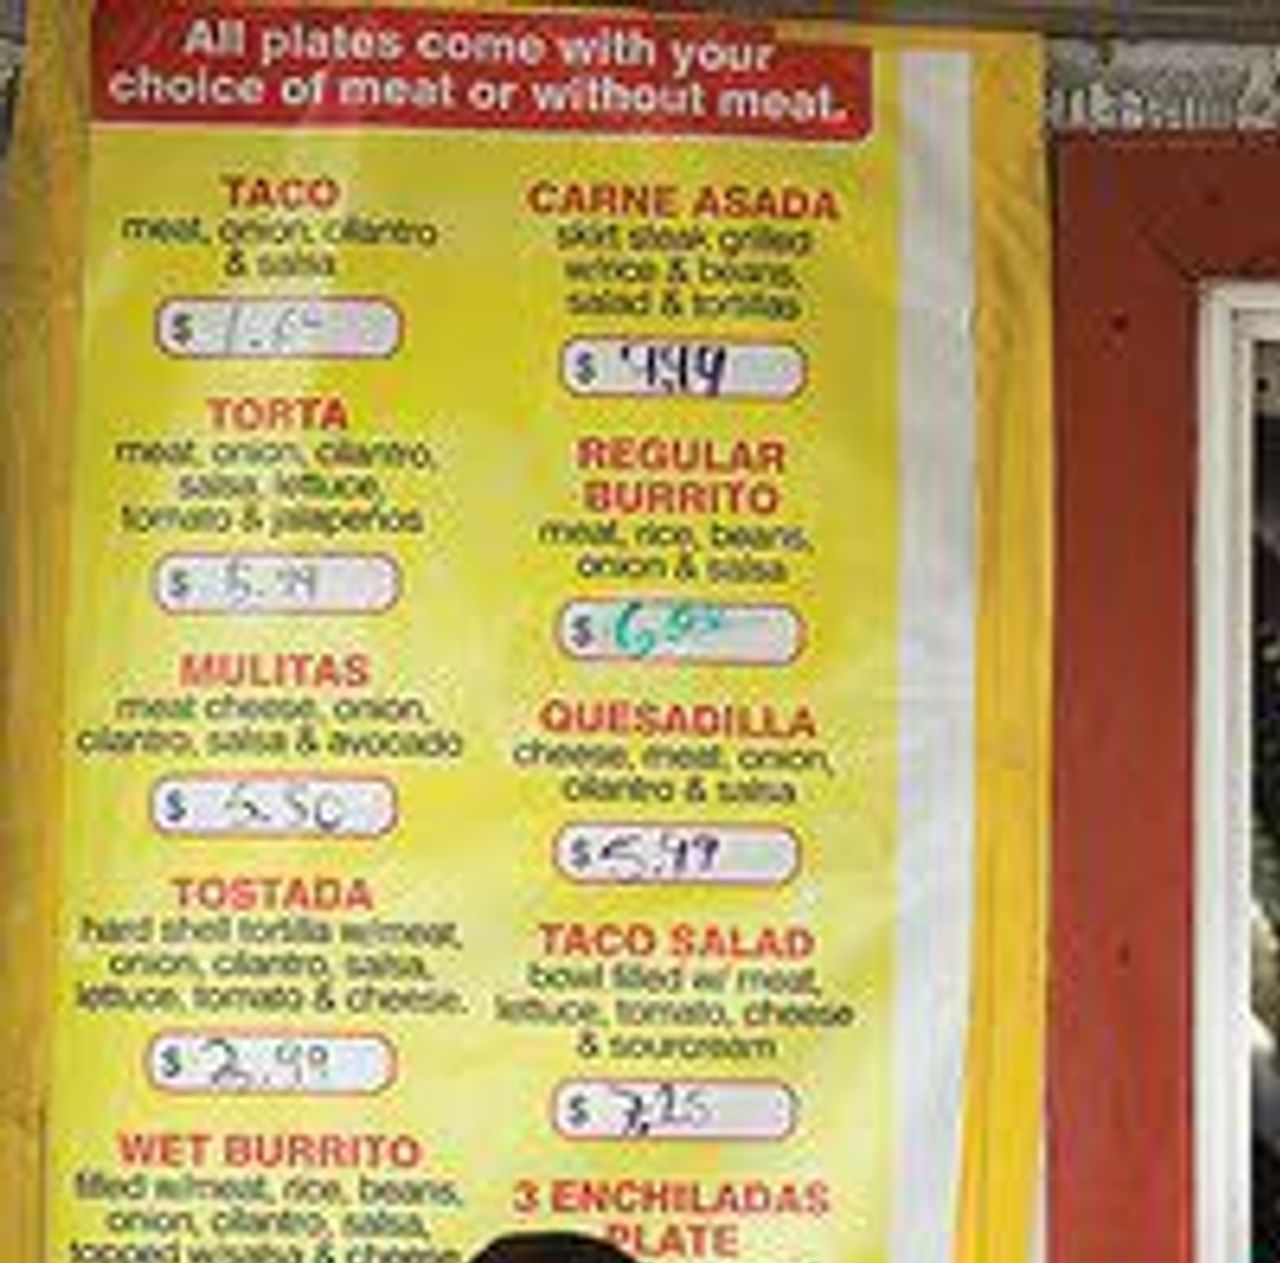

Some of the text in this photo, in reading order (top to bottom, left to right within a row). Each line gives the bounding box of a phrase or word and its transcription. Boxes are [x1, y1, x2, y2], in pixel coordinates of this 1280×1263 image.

[183, 20, 775, 76] All plates come with your
[110, 65, 850, 122] choice of meat or without meat.
[221, 176, 341, 207] TACO
[526, 181, 840, 220] CARNE ASADA
[322, 214, 439, 247] cilantro
[225, 251, 336, 278] & salsa
[666, 259, 691, 286] &
[565, 290, 802, 320] salad & tortillas
[207, 398, 349, 430] TORTA
[315, 440, 437, 470] cilantro,
[577, 436, 786, 474] REGULAR
[584, 481, 781, 515] BURRITO
[121, 506, 232, 534] tomato
[239, 507, 263, 531] &
[539, 521, 630, 549] meat,
[711, 522, 815, 555] beans,
[577, 553, 788, 583] onion & salsa
[179, 653, 371, 687] MULITAS
[539, 700, 817, 738] QUESADILLA
[206, 729, 285, 755] salsa
[296, 729, 318, 755] &
[329, 729, 463, 758] avocado
[513, 738, 636, 772] cheese,
[737, 747, 834, 776] onion,
[562, 775, 796, 804] cilantro & salsa
[171, 877, 372, 911] TOSTADA
[81, 917, 149, 943] hard
[161, 917, 231, 943] shell
[238, 917, 330, 943] tortilla
[539, 924, 816, 959] TACO SALAD
[346, 953, 432, 980] salsa,
[527, 961, 604, 989] bowl
[611, 962, 684, 991] filled
[736, 967, 821, 996] meat,
[193, 985, 303, 1011] tomato
[313, 985, 335, 1011] &
[497, 995, 854, 1028] lettuce, tomato, cheese
[576, 1031, 778, 1060] & sourcream
[118, 1134, 423, 1168] WET BURRITO
[283, 1175, 348, 1204] rice,
[358, 1175, 464, 1207] beans,
[514, 1180, 830, 1215] 3 ENCHILADAS
[345, 1209, 430, 1238] salsa,
[608, 1224, 740, 1258] PLATE
